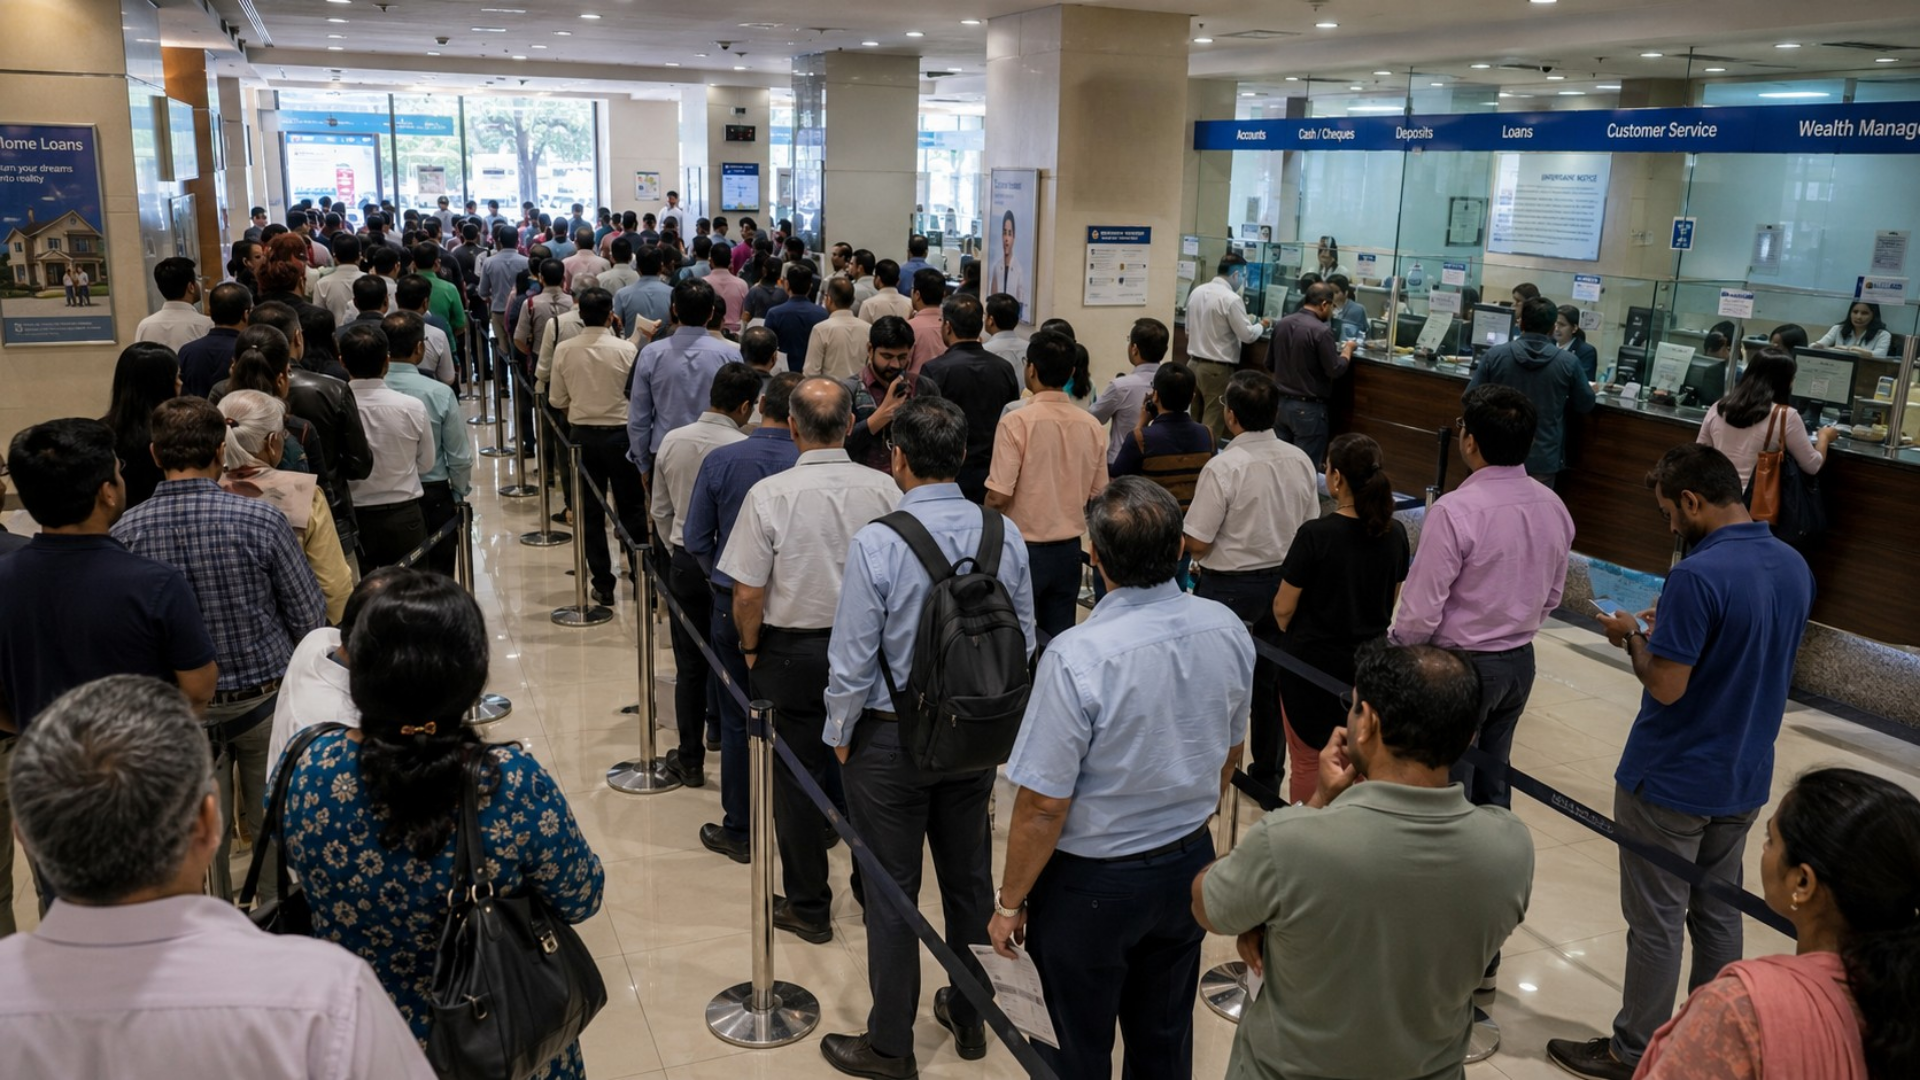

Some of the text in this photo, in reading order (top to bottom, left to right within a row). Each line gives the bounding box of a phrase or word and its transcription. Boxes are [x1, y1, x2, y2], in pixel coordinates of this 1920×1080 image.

[1236, 129, 1267, 141] Accounts
[1298, 128, 1317, 140] Cash
[1321, 127, 1356, 143] Cheques
[1395, 126, 1434, 143] Deposits
[1501, 124, 1534, 139] Loans
[1606, 121, 1718, 139] Customer Service
[1799, 118, 1920, 141] Wealth Manag
[40, 137, 83, 151] Loans
[18, 164, 37, 174] your
[40, 164, 73, 173] dreams
